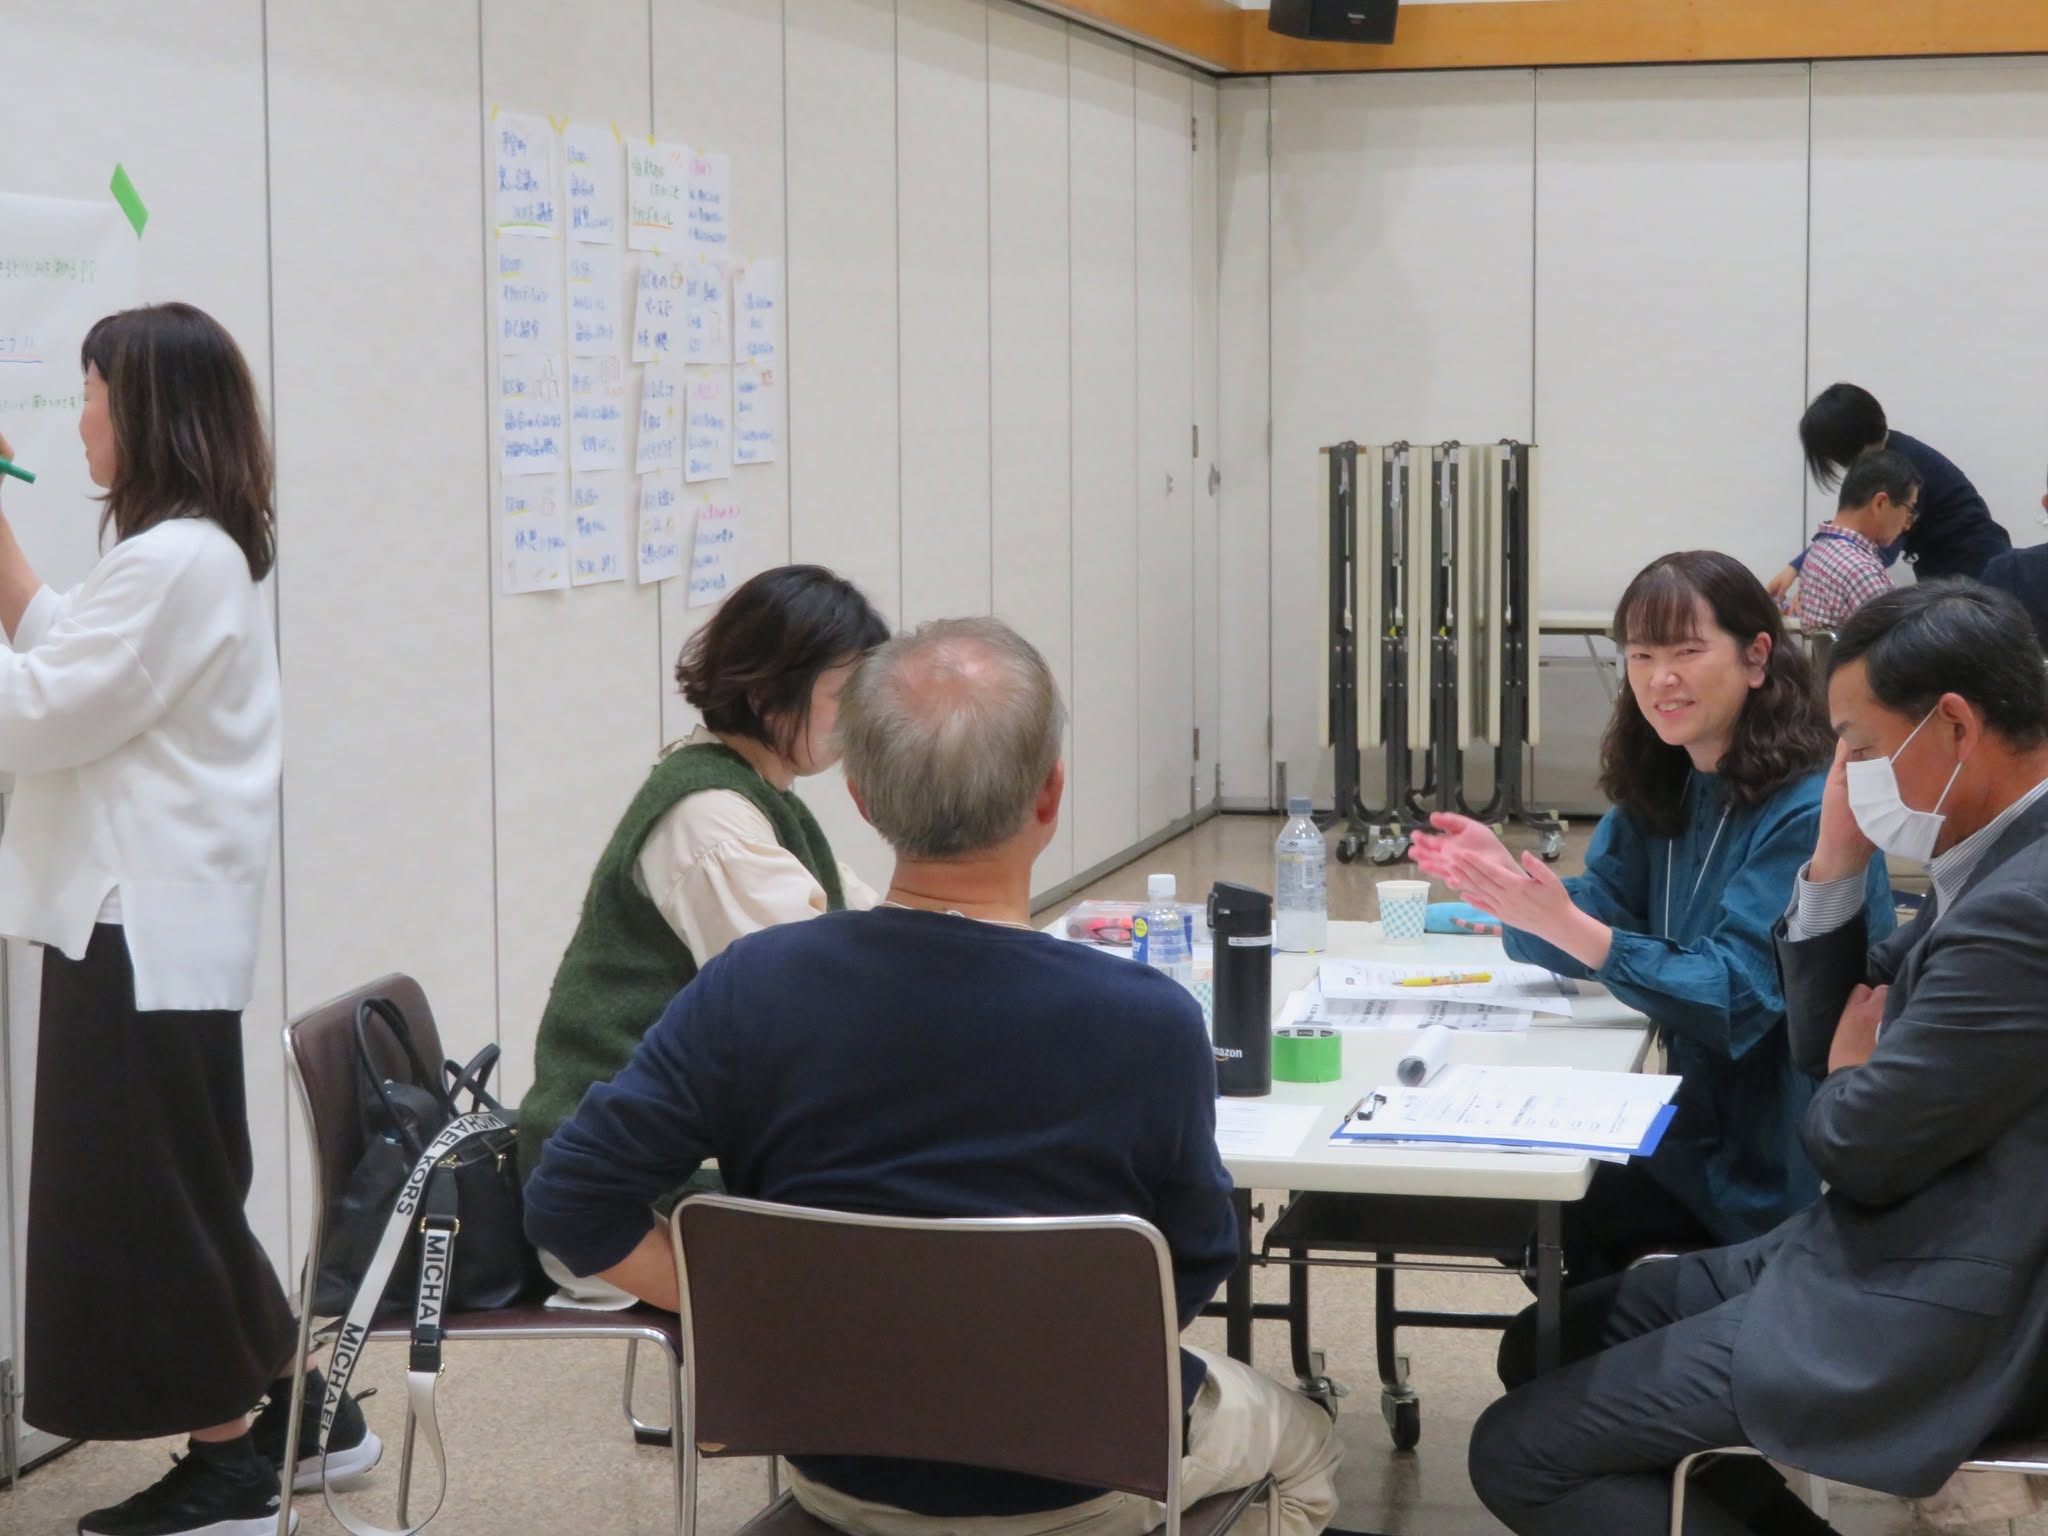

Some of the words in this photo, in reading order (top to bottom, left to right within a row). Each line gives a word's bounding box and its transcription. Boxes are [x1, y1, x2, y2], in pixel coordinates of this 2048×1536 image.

[432, 1114, 502, 1149] MICHAEL
[396, 1155, 437, 1216] KORS
[320, 1322, 365, 1434] MICHAEL
